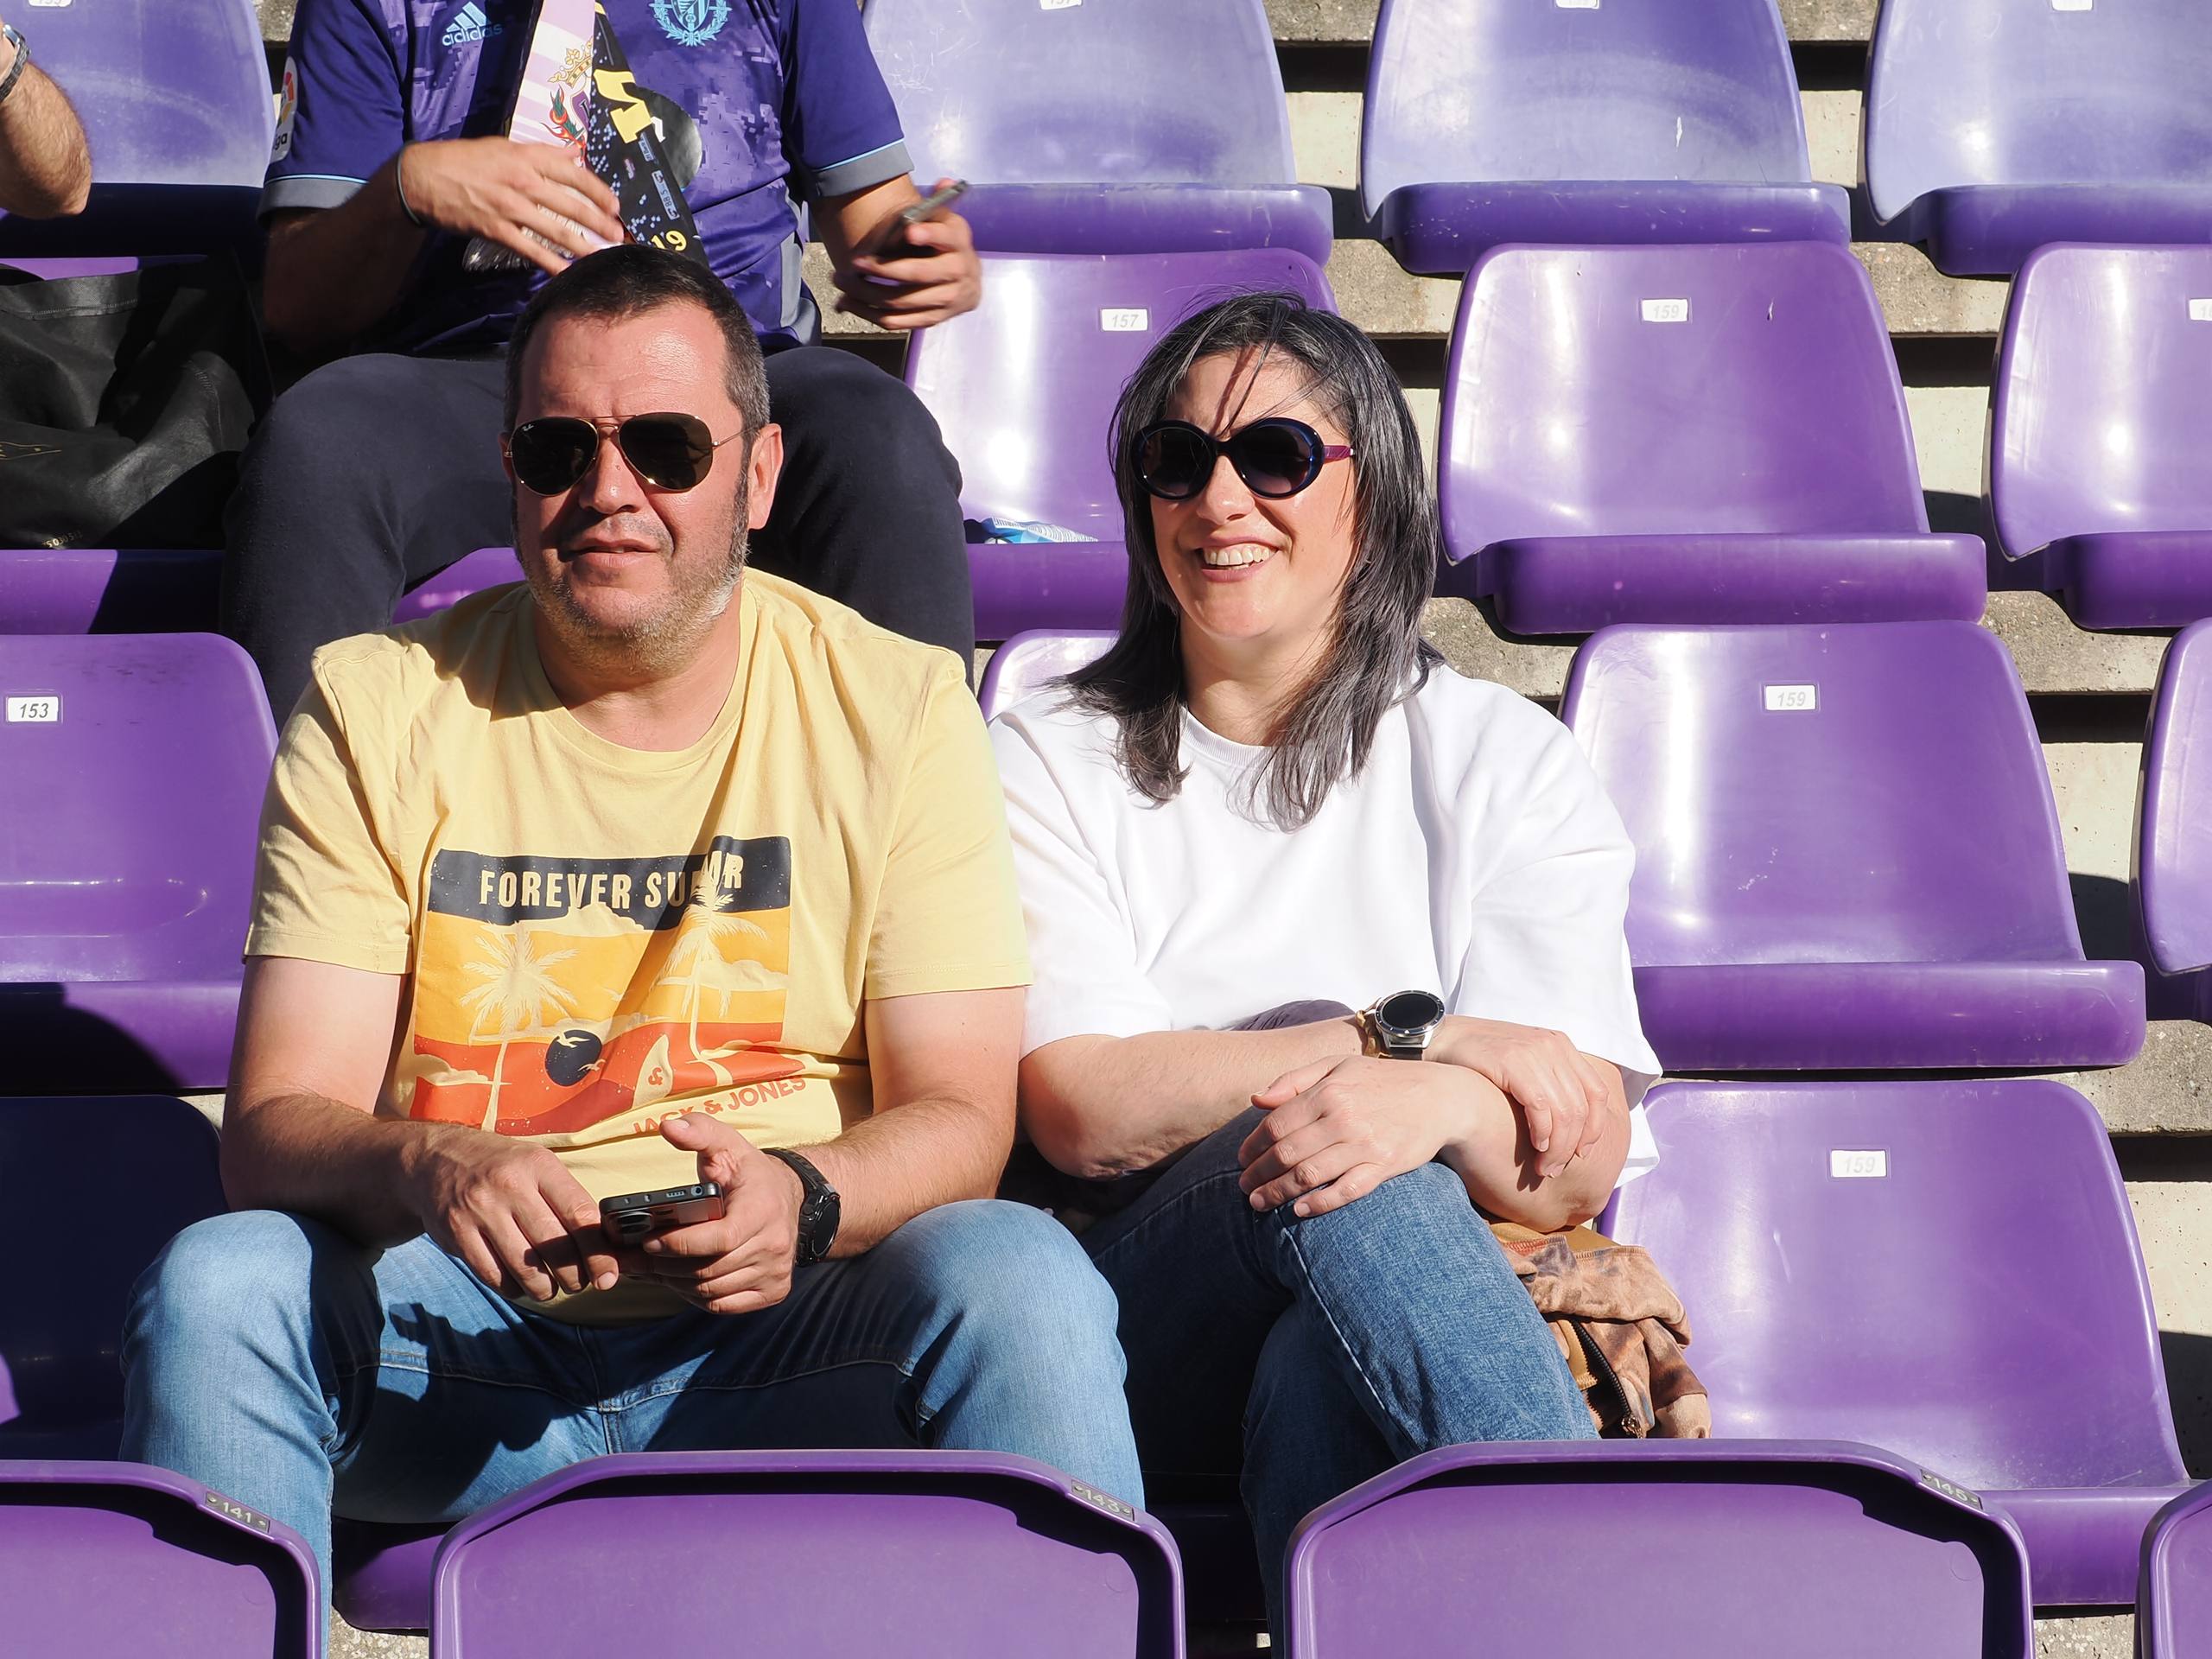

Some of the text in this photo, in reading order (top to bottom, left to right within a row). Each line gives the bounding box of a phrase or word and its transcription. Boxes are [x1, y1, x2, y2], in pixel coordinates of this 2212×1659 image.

[442, 23, 503, 47] adidas
[1111, 313, 1140, 328] 157
[1652, 304, 1681, 320] 159
[1777, 690, 1808, 708] 159
[19, 702, 50, 719] 153
[480, 869, 632, 909] FOREVER
[703, 1099, 723, 1115] &
[728, 1076, 806, 1111] JONES
[1843, 1156, 1877, 1174] 159
[1933, 1476, 1968, 1502] 145
[222, 1501, 253, 1523] 141
[1084, 1489, 1121, 1514] 143
